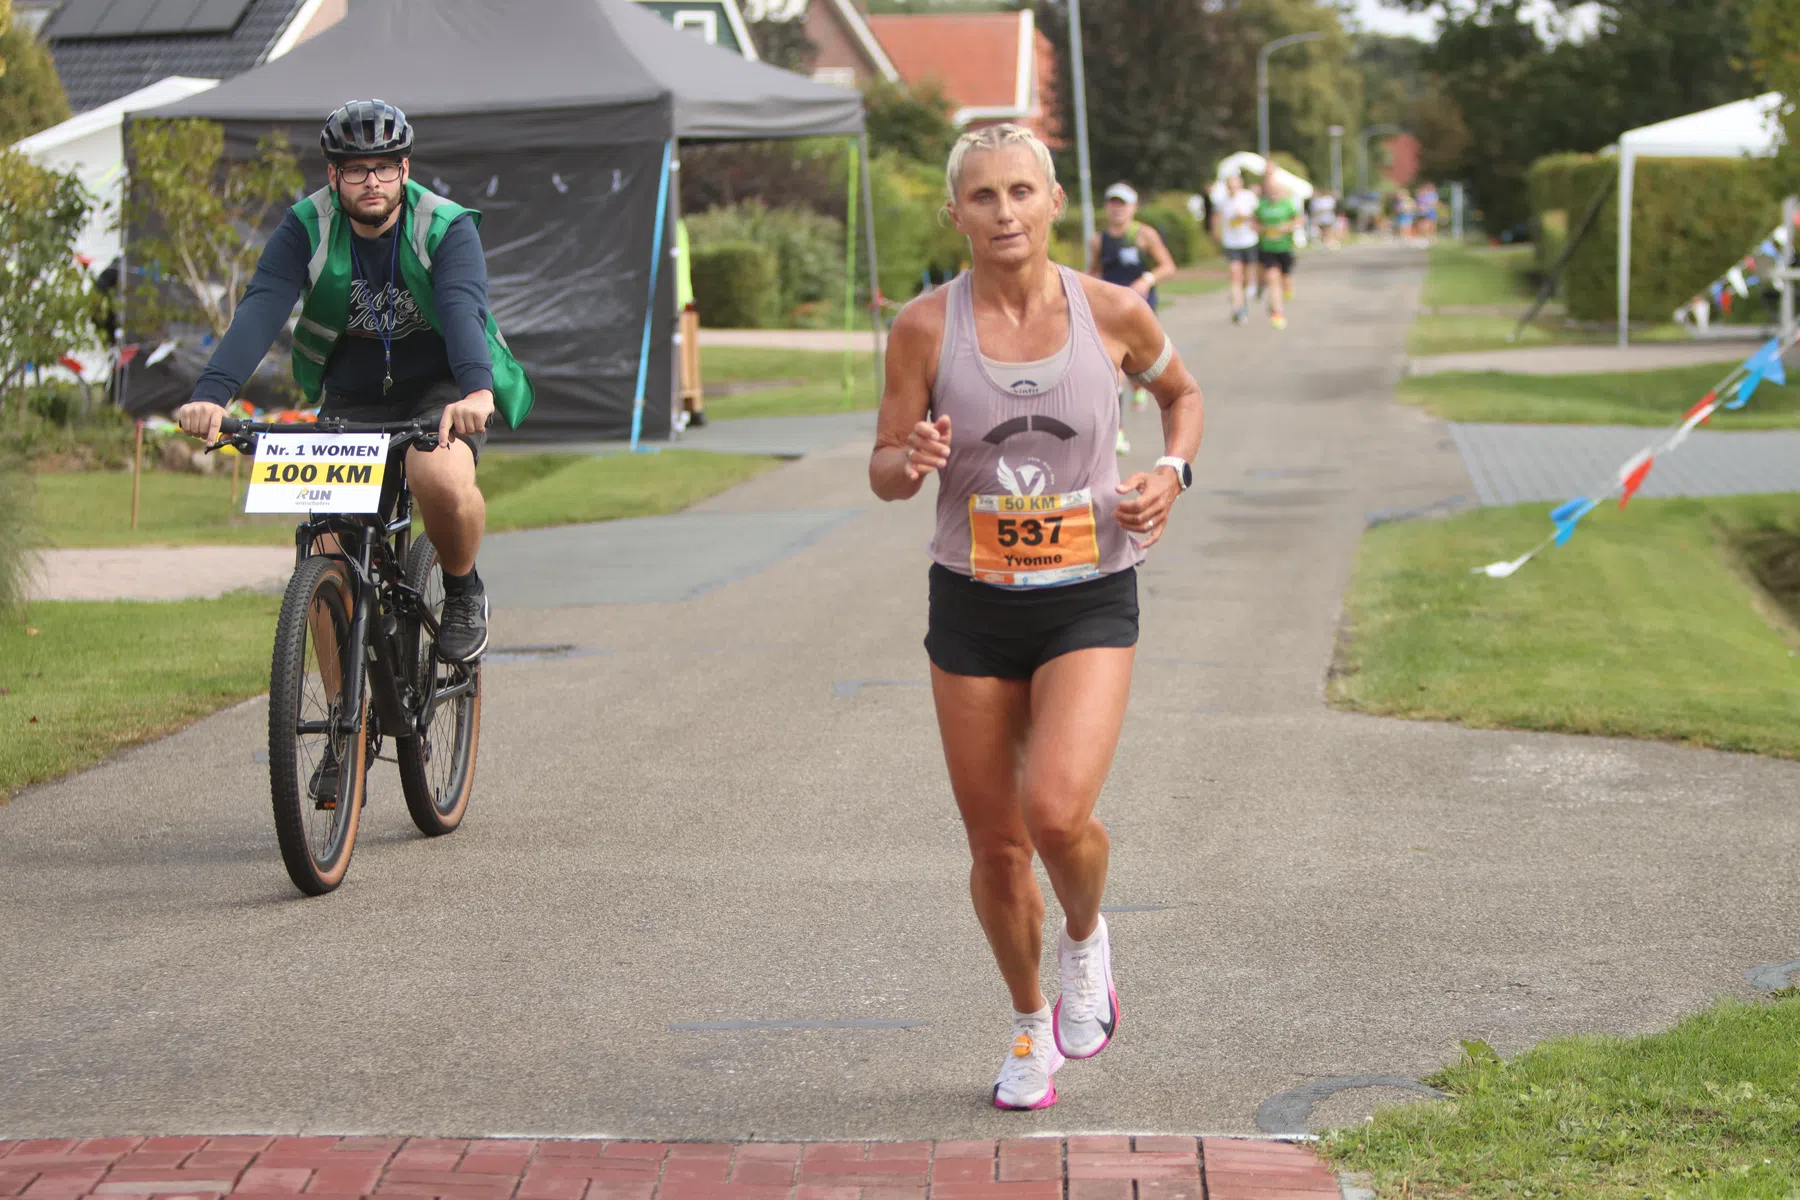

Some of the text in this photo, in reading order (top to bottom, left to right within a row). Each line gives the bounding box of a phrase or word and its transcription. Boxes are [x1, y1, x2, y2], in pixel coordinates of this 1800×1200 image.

[266, 444, 380, 457] Nr. 1 WOMEN
[263, 464, 373, 484] 100 KM
[296, 488, 333, 501] RUN
[1004, 498, 1025, 511] 50
[1030, 497, 1056, 510] KM
[997, 516, 1064, 548] 537
[1004, 554, 1063, 567] Yvonne
